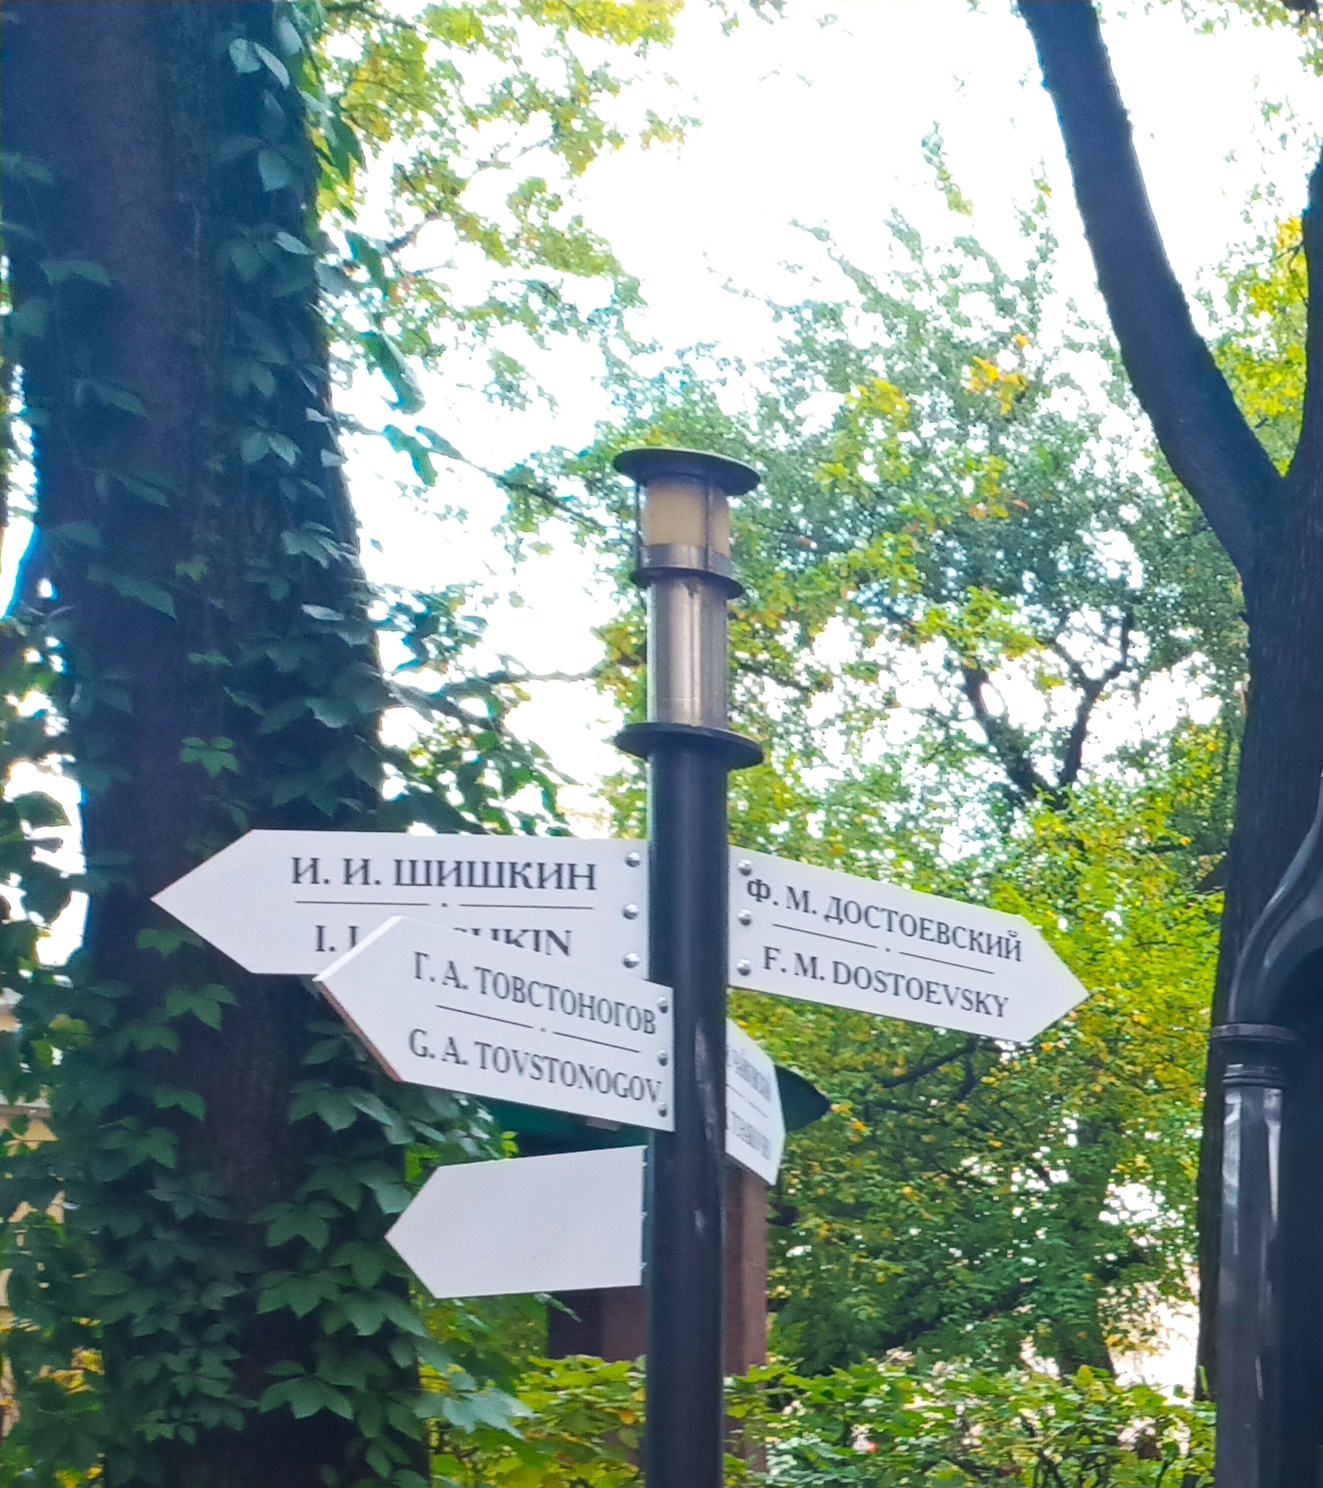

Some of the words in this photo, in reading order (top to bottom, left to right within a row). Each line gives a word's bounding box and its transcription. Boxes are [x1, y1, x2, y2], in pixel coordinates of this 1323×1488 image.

[290, 857, 330, 885] И.
[342, 858, 382, 885] И.
[392, 859, 597, 890] ШИШКИН
[315, 925, 336, 952] I.
[746, 878, 779, 906] Ф.
[786, 885, 818, 915] М.
[823, 895, 1023, 962] ДОСТОЕВСКИЙ
[414, 951, 436, 982] Г.
[442, 960, 469, 990] А.
[474, 966, 656, 1034] ТОВСТОНОГОВ
[763, 946, 787, 973] F.
[794, 953, 825, 981] M.
[832, 960, 1009, 1018] DOSTOEVSKY
[408, 1028, 434, 1059] G.
[441, 1037, 468, 1066] A.
[474, 1041, 662, 1103] TOVSTONOGOV
